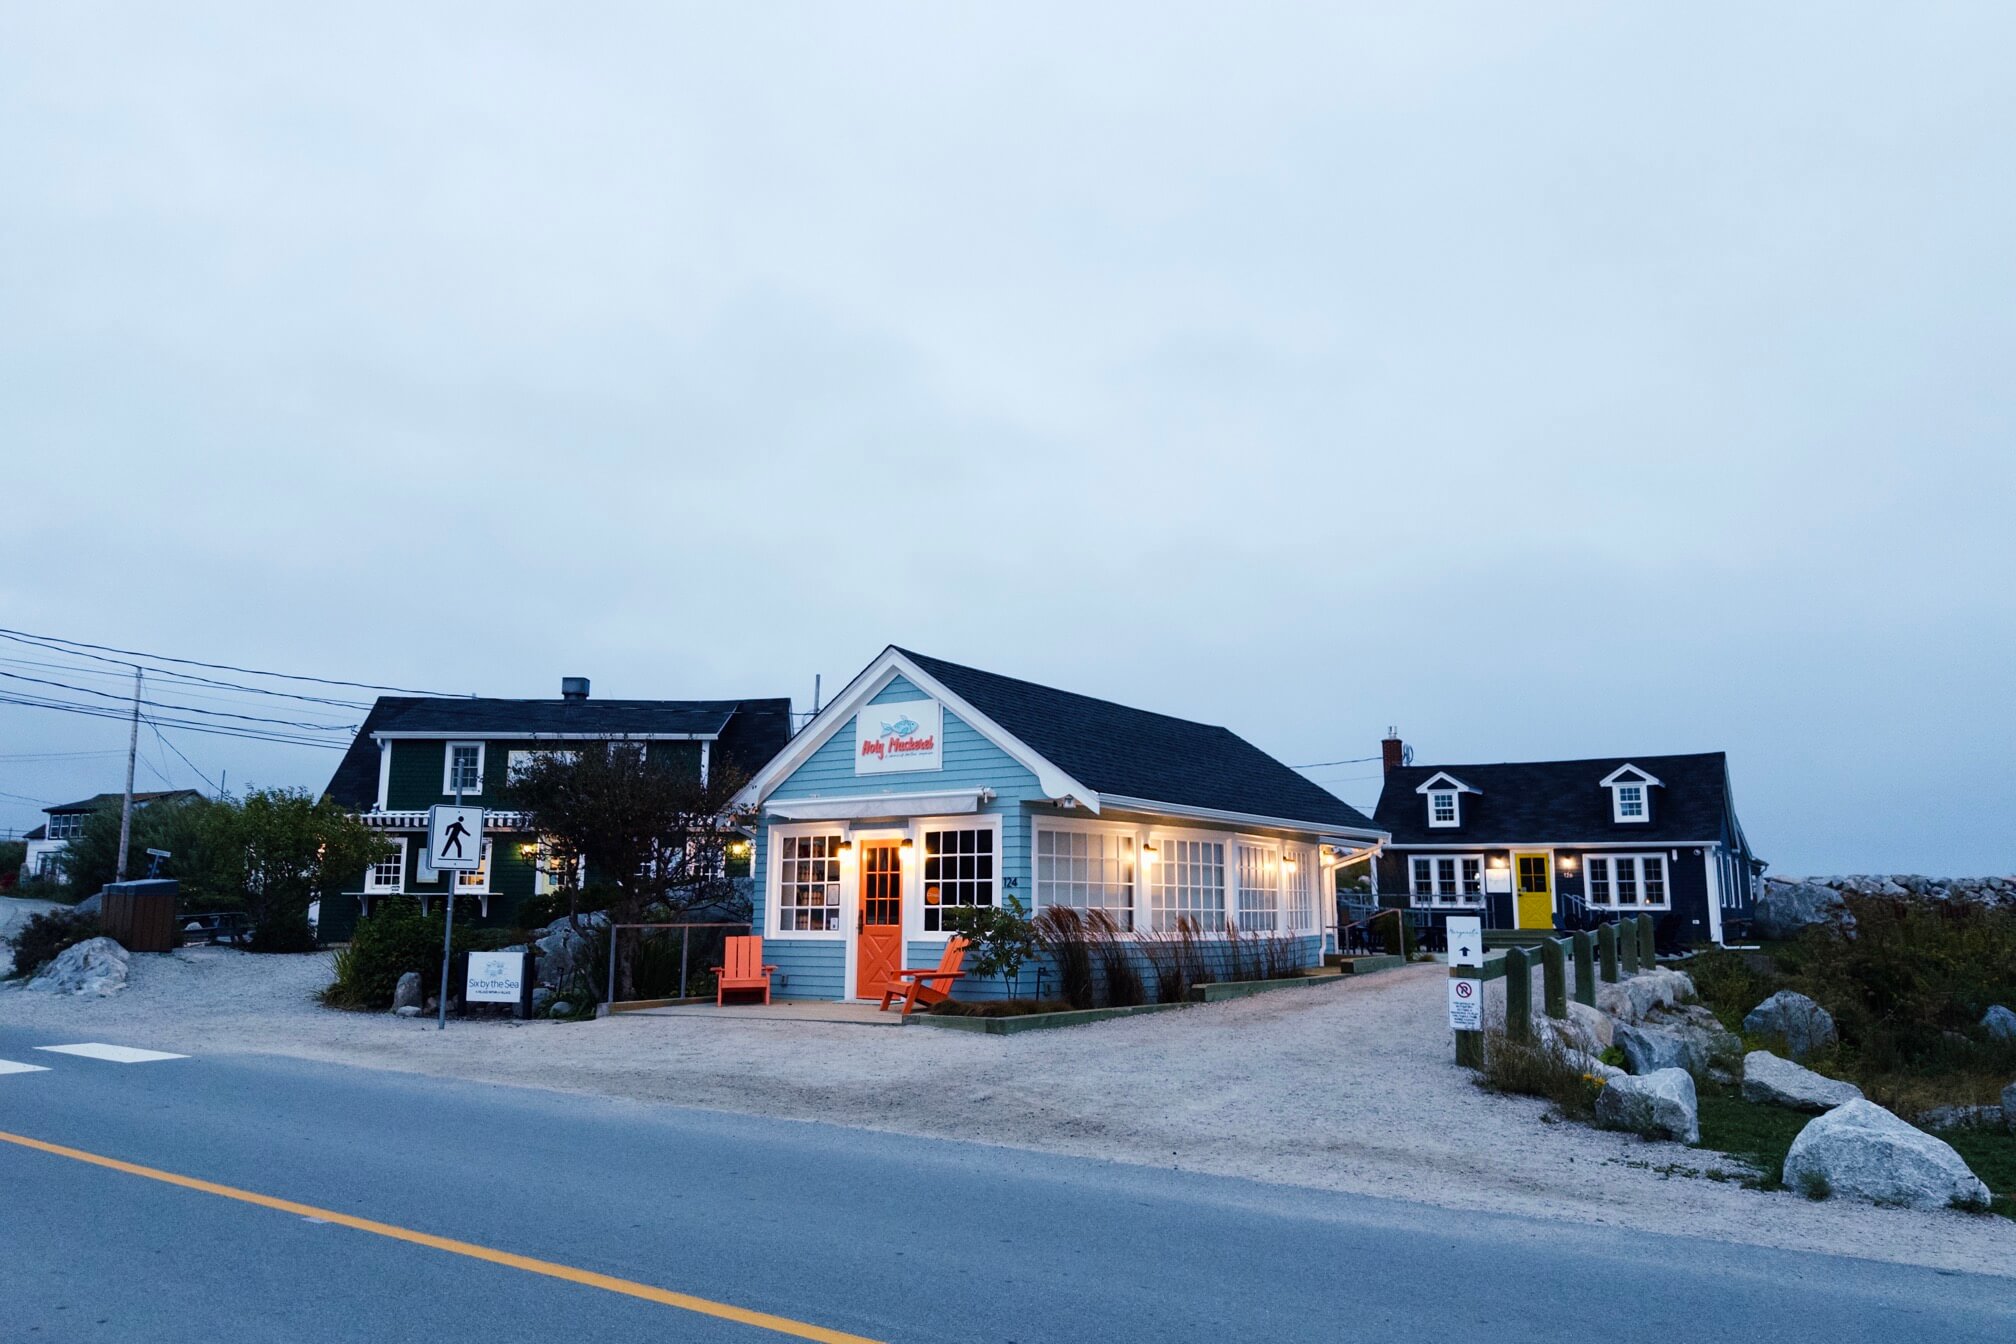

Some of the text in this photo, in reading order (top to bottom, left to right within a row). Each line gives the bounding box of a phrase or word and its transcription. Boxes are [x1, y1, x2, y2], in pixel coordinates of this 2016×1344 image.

[861, 739, 885, 760] Holy
[1003, 877, 1018, 888] 124
[469, 978, 519, 989] Six by the Sea
